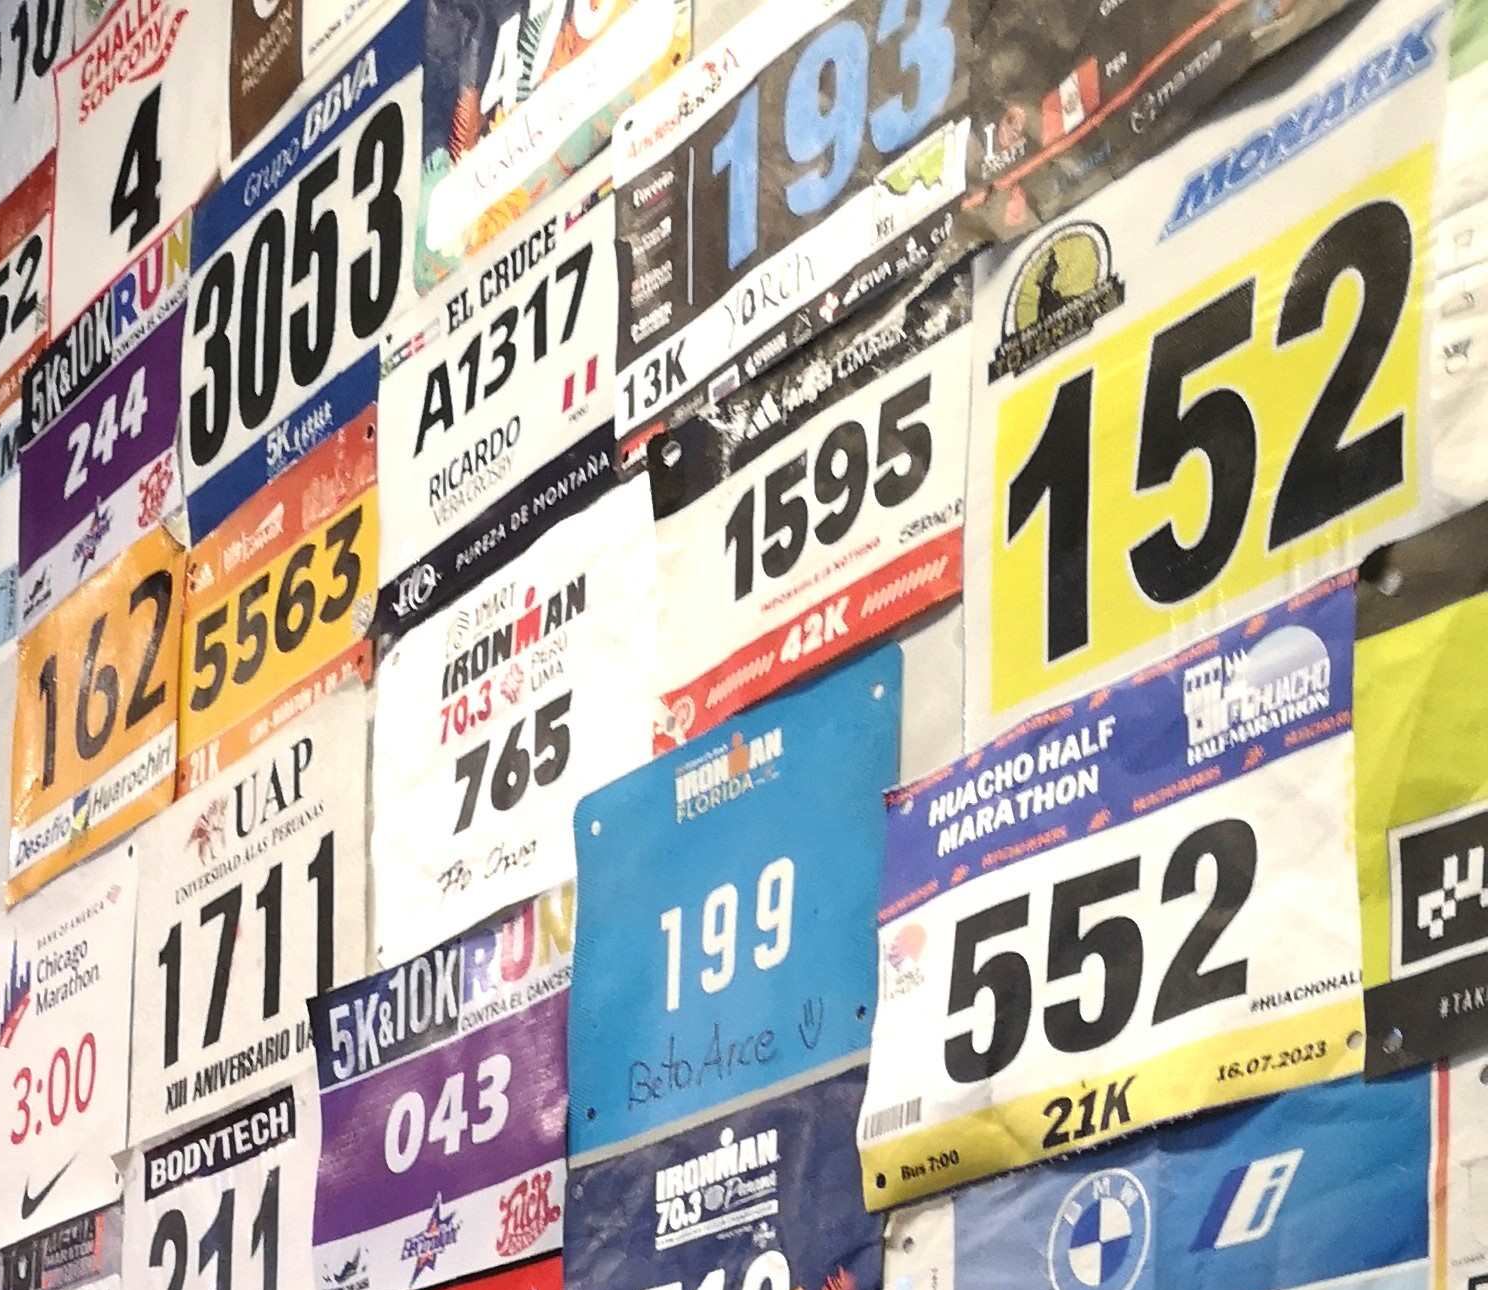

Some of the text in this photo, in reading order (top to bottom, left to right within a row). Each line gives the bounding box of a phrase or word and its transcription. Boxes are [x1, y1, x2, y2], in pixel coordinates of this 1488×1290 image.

[189, 101, 404, 467] 3053
[447, 219, 558, 331] EL CRUCE
[414, 241, 594, 459] A1317
[622, 338, 689, 421] 13K
[65, 366, 148, 497] 244
[428, 414, 522, 508] RICARDO
[723, 374, 933, 602] 1595
[1006, 200, 1413, 664] 152
[189, 505, 362, 713] 5563
[778, 598, 852, 665] 42K
[39, 570, 173, 791] 162
[235, 737, 314, 839] UAP
[453, 689, 573, 836] 765
[929, 714, 1116, 827] HUACHO HALF
[937, 766, 1100, 858] MARATHON
[35, 938, 89, 984] Chicago
[35, 963, 101, 1017] Marathon
[159, 830, 335, 1069] 1711
[660, 857, 795, 1012] 199
[944, 818, 1259, 1085] 552
[10, 1032, 97, 1145] 3:00
[385, 1054, 512, 1174] 043
[1041, 1074, 1138, 1150] 21K
[1215, 1040, 1328, 1083] 16.07.2023
[149, 1100, 291, 1191] BODYTECH
